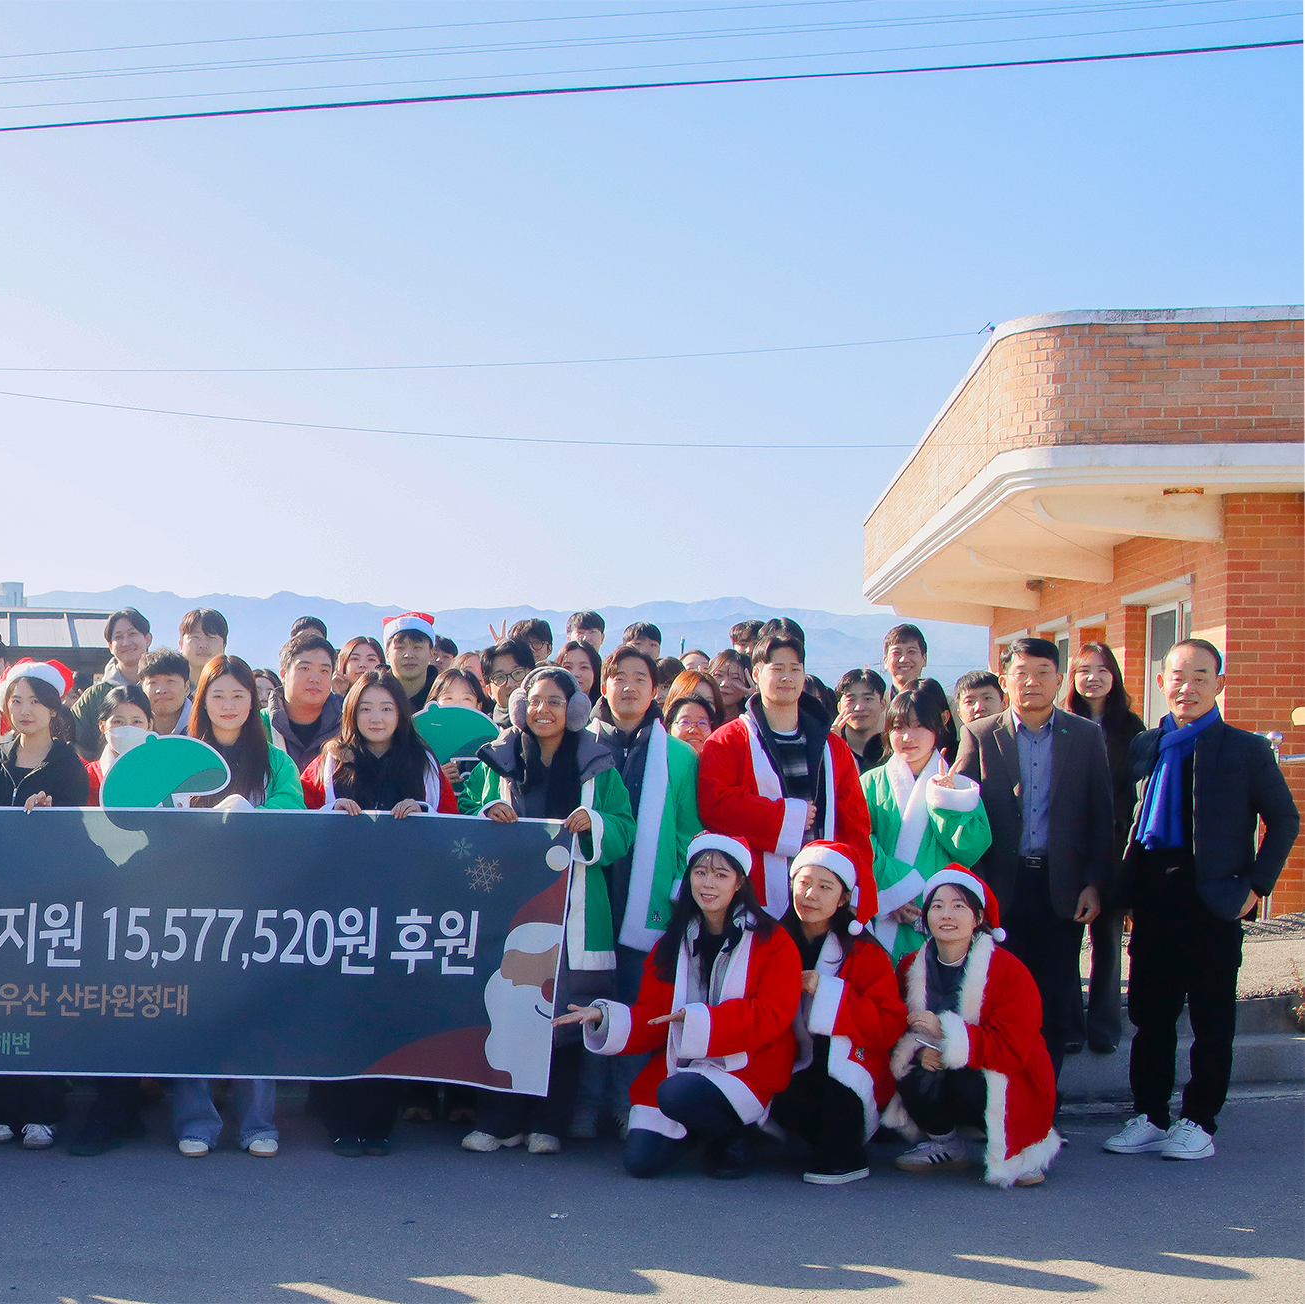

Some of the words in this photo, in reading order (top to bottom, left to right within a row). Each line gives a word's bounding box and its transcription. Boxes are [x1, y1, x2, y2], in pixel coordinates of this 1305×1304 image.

[102, 906, 378, 976] 15,577,520원
[390, 908, 480, 976] 후원
[56, 984, 190, 1018] 산타원정대
